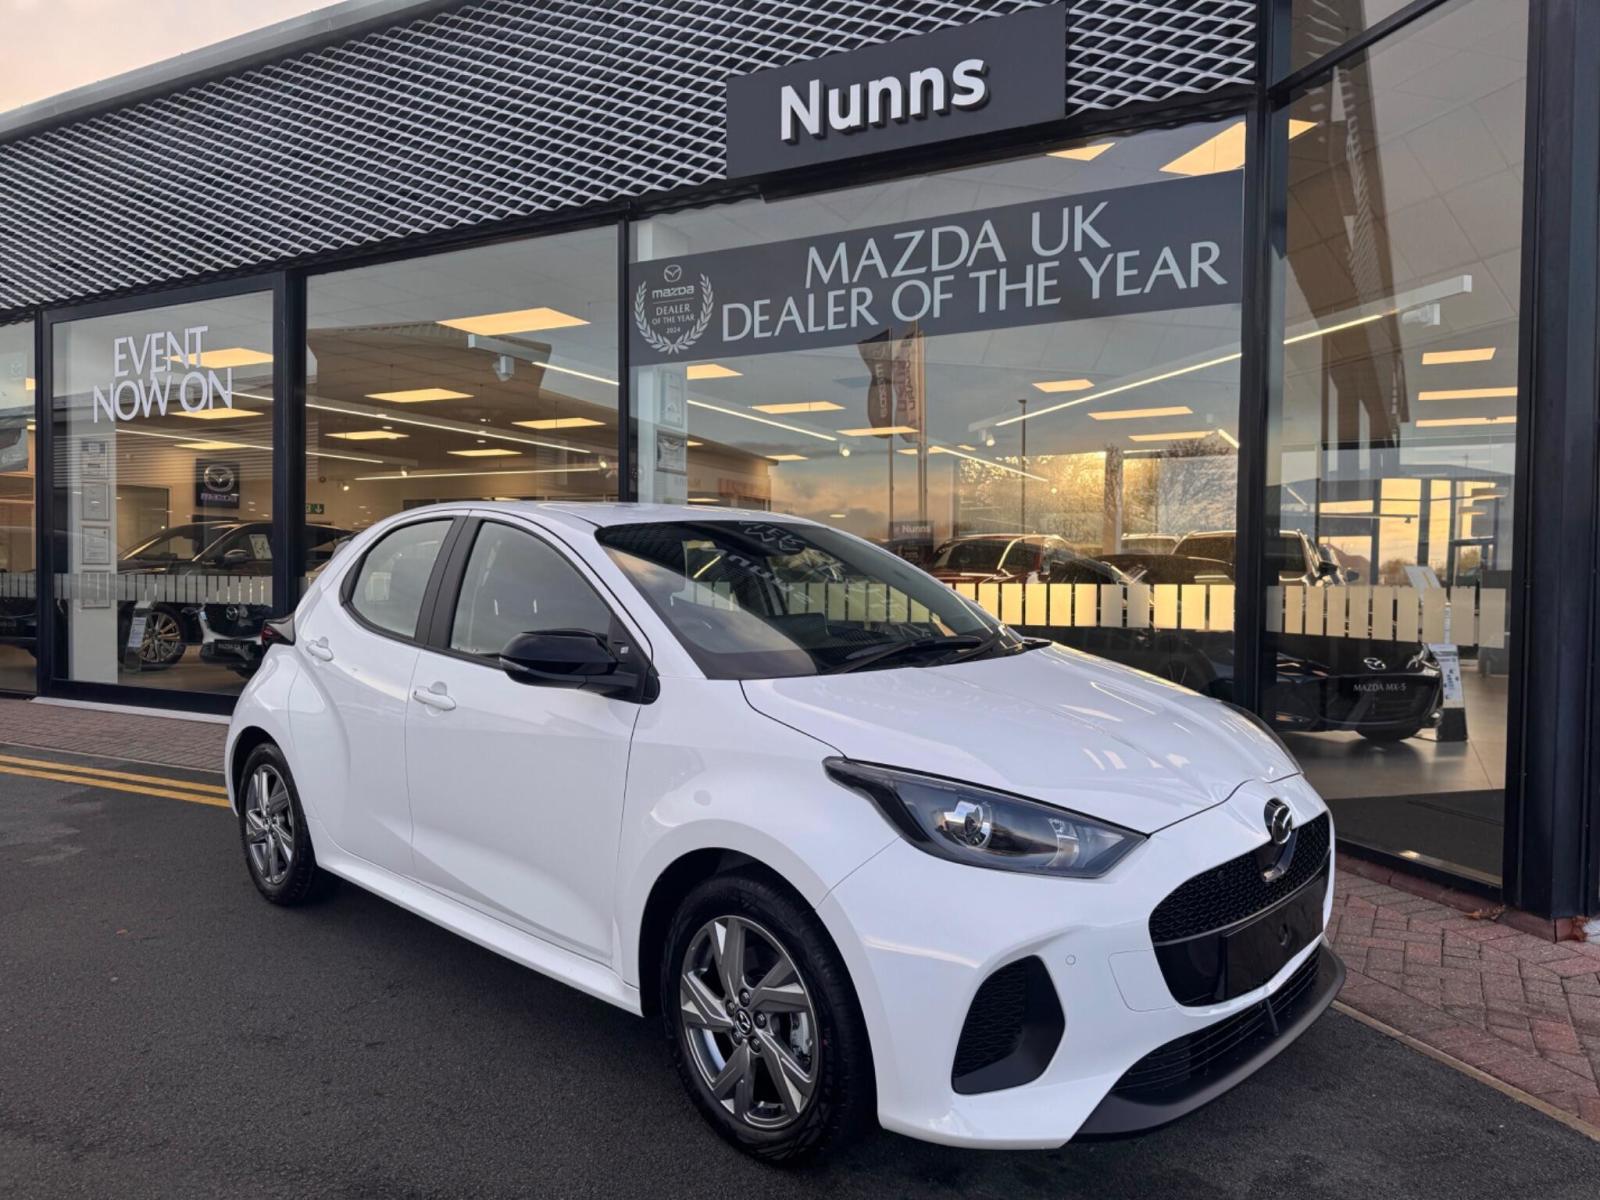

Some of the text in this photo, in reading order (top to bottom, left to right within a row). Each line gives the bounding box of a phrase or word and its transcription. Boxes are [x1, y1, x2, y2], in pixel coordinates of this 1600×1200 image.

[781, 59, 987, 141] Nunns
[805, 200, 1112, 288] MAZDA UK
[652, 285, 695, 299] mazda
[656, 303, 690, 316] DEALER
[722, 240, 1228, 342] DEALER OF THE YEAR
[652, 314, 695, 326] OF THE YEAR
[114, 325, 208, 378] EVENT
[93, 367, 233, 424] NOW ON
[1353, 682, 1407, 692] MAZDA MX-5
